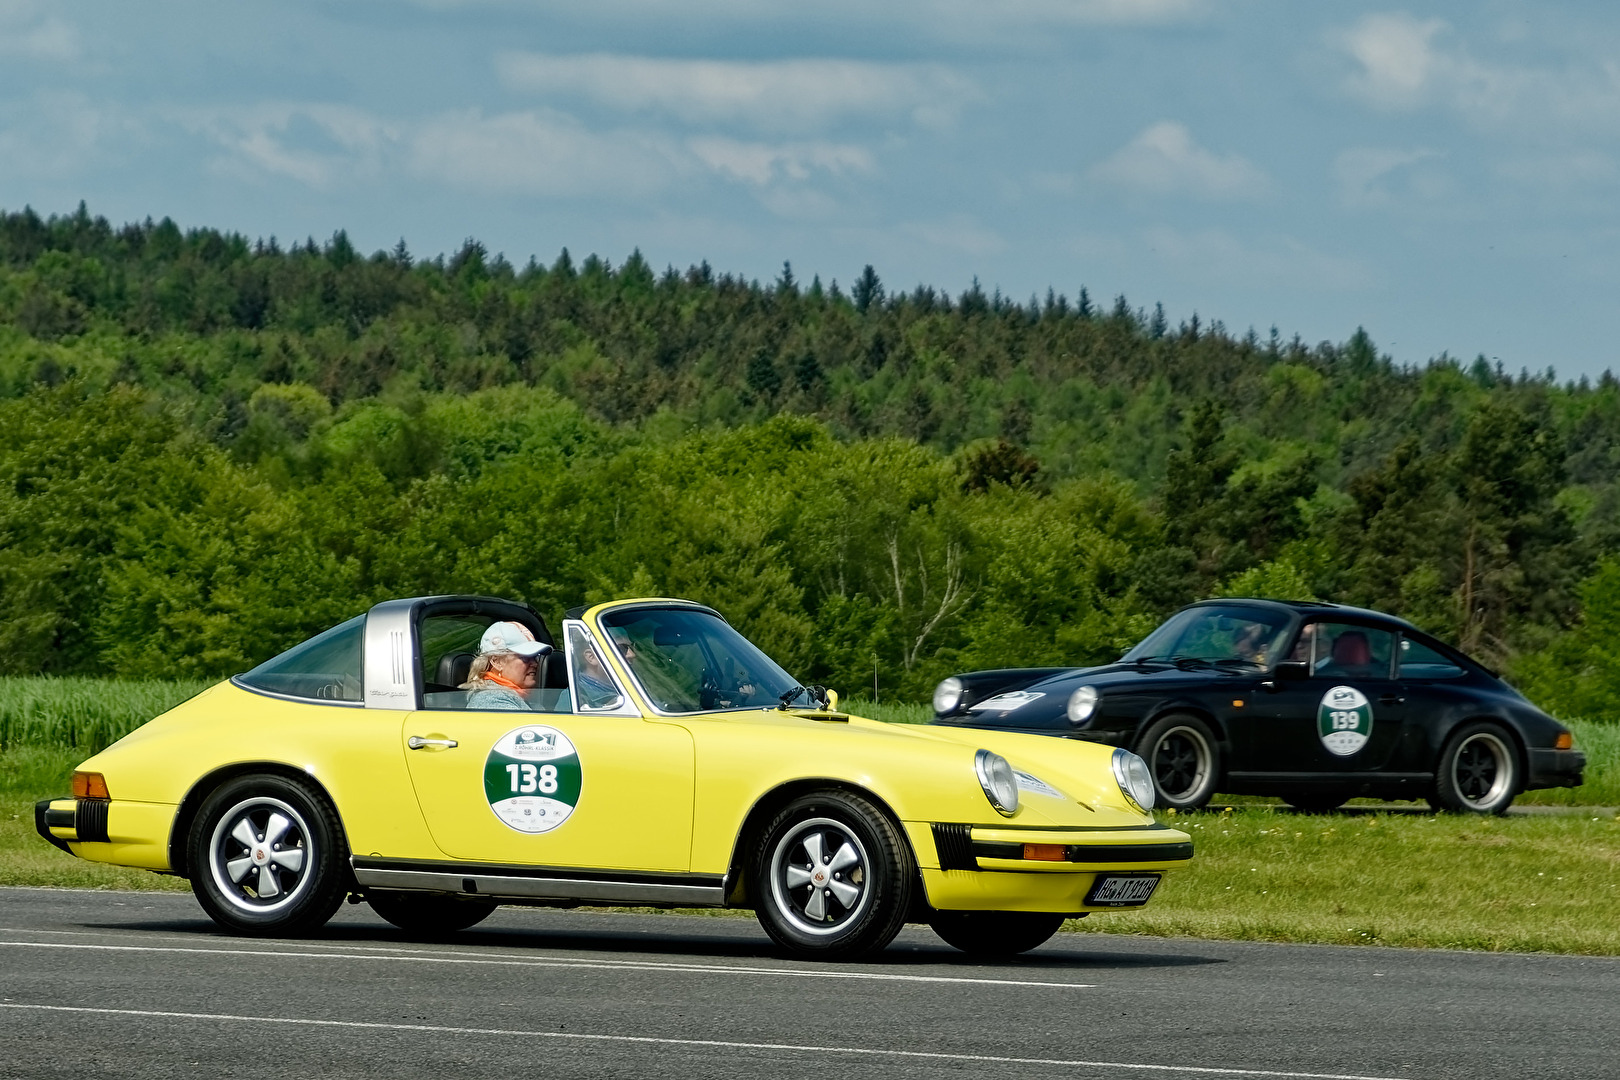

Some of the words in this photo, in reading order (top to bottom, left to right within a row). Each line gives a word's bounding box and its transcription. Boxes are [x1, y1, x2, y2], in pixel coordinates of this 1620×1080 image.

[1329, 711, 1360, 730] 139
[506, 763, 558, 794] 138
[757, 809, 787, 863] DUNLOP
[1097, 880, 1117, 899] HG
[1114, 880, 1134, 899] AT
[1127, 880, 1157, 899] 911H
